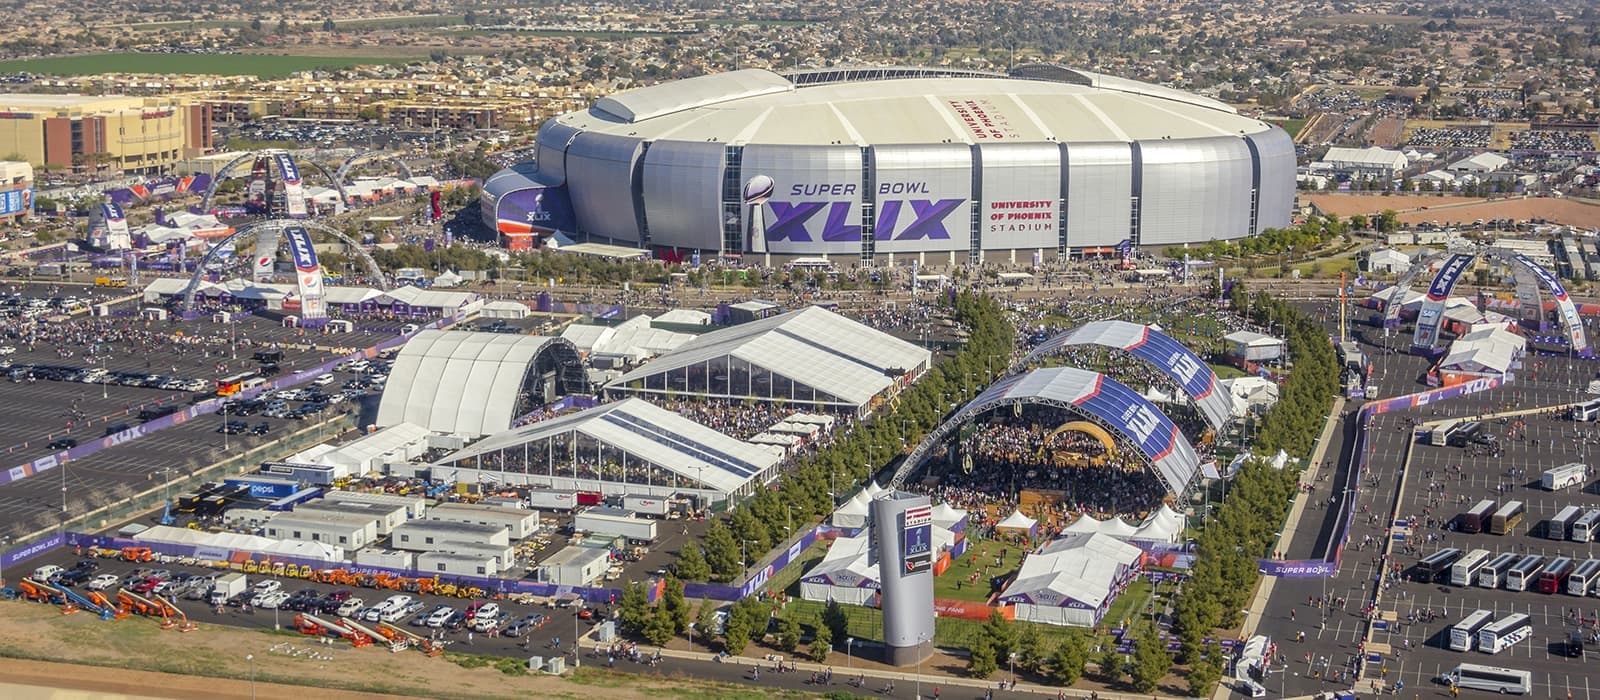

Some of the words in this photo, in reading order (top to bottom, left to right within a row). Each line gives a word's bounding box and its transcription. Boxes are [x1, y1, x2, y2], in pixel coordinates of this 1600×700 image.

[949, 100, 987, 139] UNIVERSITY
[965, 100, 994, 127] PHOENIX
[989, 129, 1004, 139] OF
[790, 183, 857, 196] SUPER
[879, 182, 930, 194] BOWL
[991, 201, 1052, 209] UNIVERSITY
[527, 211, 551, 221] XLIX
[766, 199, 967, 242] XLIX
[1007, 212, 1052, 220] PHOENIX
[990, 224, 1052, 232] STADIUM
[1171, 353, 1200, 385] XLIX
[1462, 378, 1492, 395] XLIX
[1126, 404, 1160, 445] XLIX
[111, 427, 142, 446] XLIX
[252, 485, 274, 494] pepsi
[1275, 566, 1304, 574] SUPER
[1306, 566, 1330, 574] BOWL
